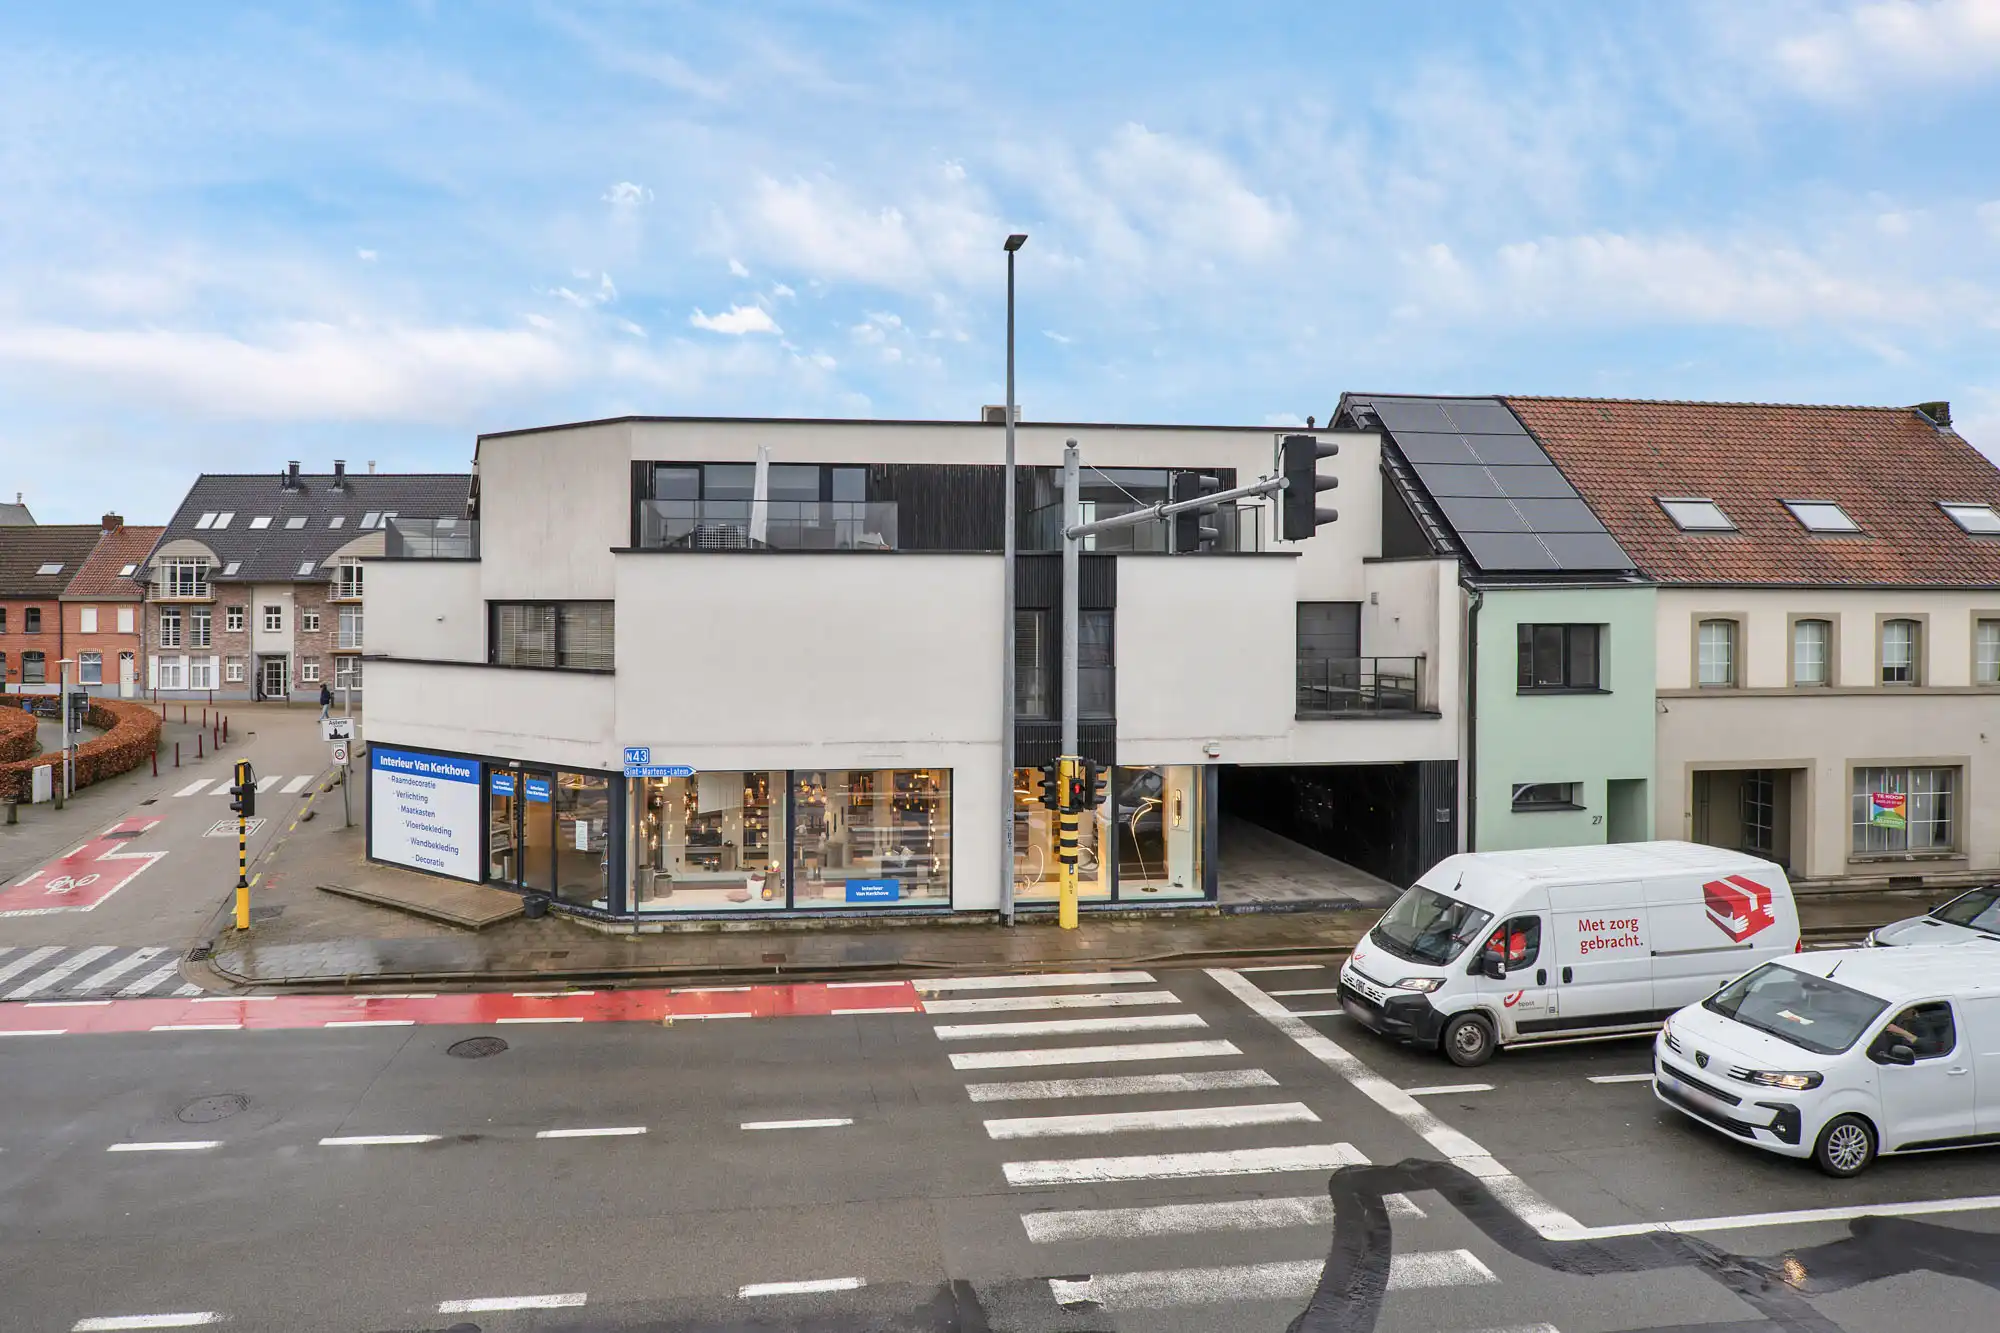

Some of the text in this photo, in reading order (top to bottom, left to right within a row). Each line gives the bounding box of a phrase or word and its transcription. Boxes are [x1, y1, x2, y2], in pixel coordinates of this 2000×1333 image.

[626, 750, 647, 762] N43
[380, 755, 471, 777] Interieur Van Kerkhove
[625, 767, 689, 776] Sint-Martens-Latem
[391, 775, 437, 789] Raamdecoratie
[395, 790, 429, 804] Verlichting
[400, 805, 436, 818] Maatkasten
[1592, 815, 1603, 825] 27
[405, 820, 452, 837] Vloerbekleding
[410, 837, 459, 856] Wandbekleding
[415, 854, 445, 868] Decoratie
[1578, 918, 1639, 932] Met zorg
[1580, 933, 1644, 954] gebracht.
